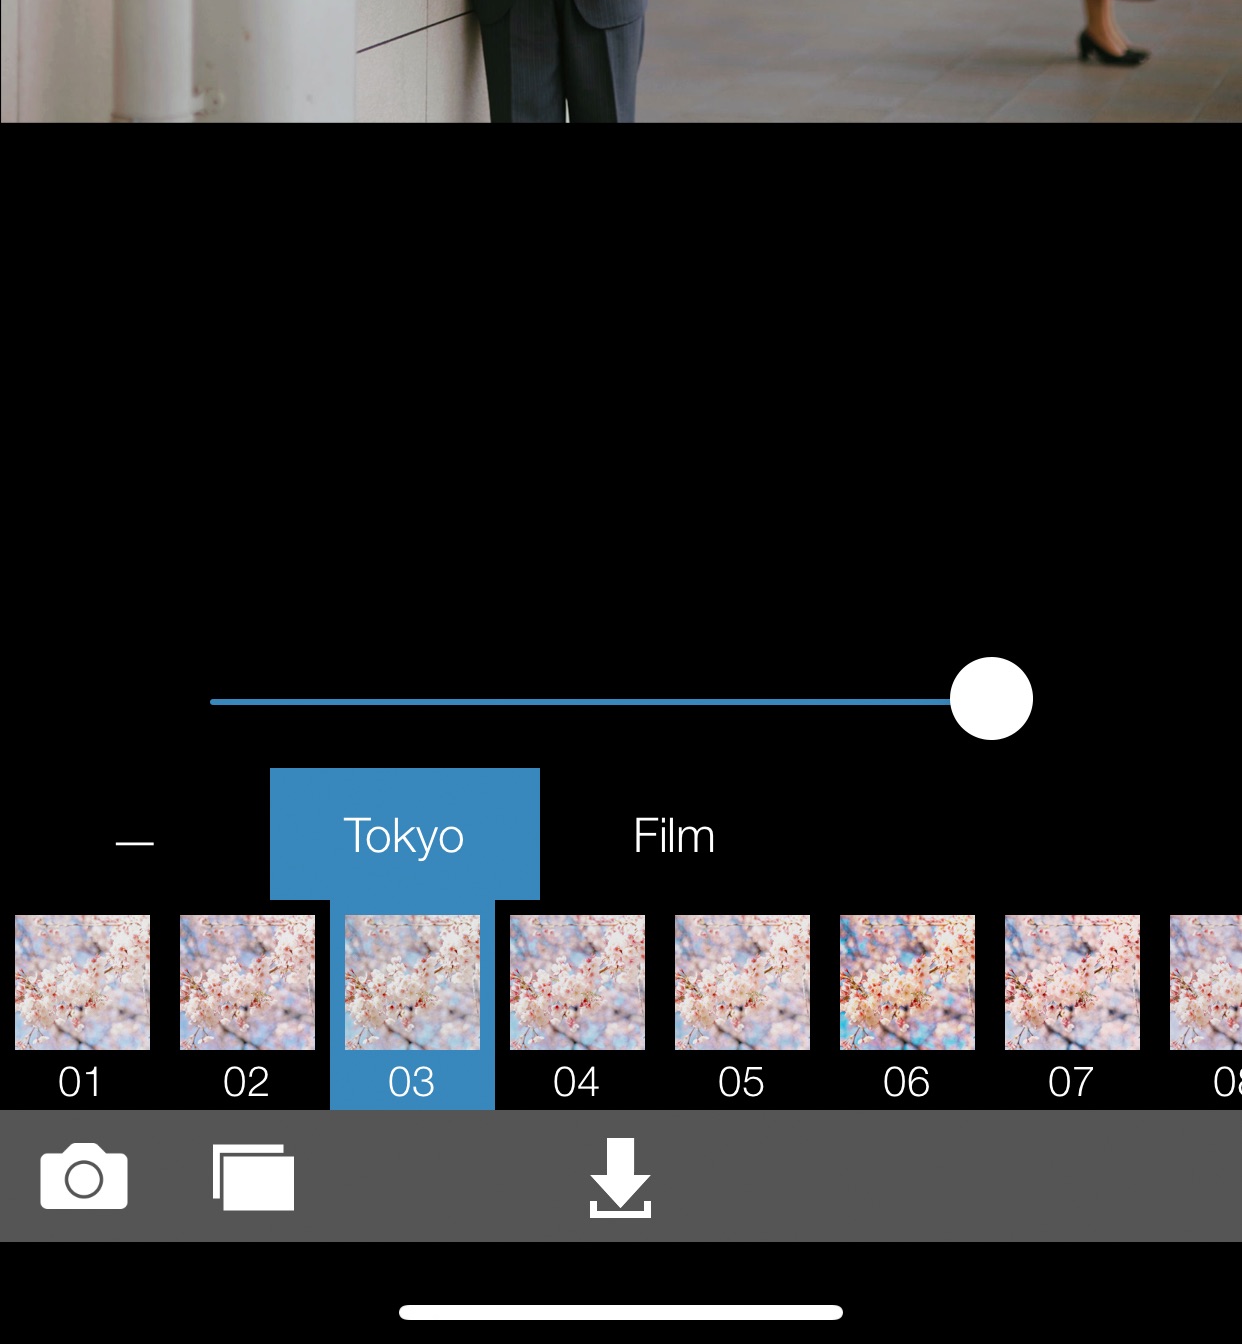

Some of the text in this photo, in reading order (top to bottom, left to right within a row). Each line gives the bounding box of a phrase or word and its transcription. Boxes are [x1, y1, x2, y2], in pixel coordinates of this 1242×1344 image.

[343, 817, 464, 862] Tokyo
[636, 817, 714, 853] Film
[59, 1066, 97, 1097] 01
[224, 1066, 269, 1097] 02
[389, 1066, 434, 1097] 03
[554, 1066, 599, 1097] 04
[719, 1066, 764, 1097] 05
[884, 1066, 930, 1097] 06
[1049, 1066, 1094, 1097] 07
[1214, 1066, 1242, 1097] 0
